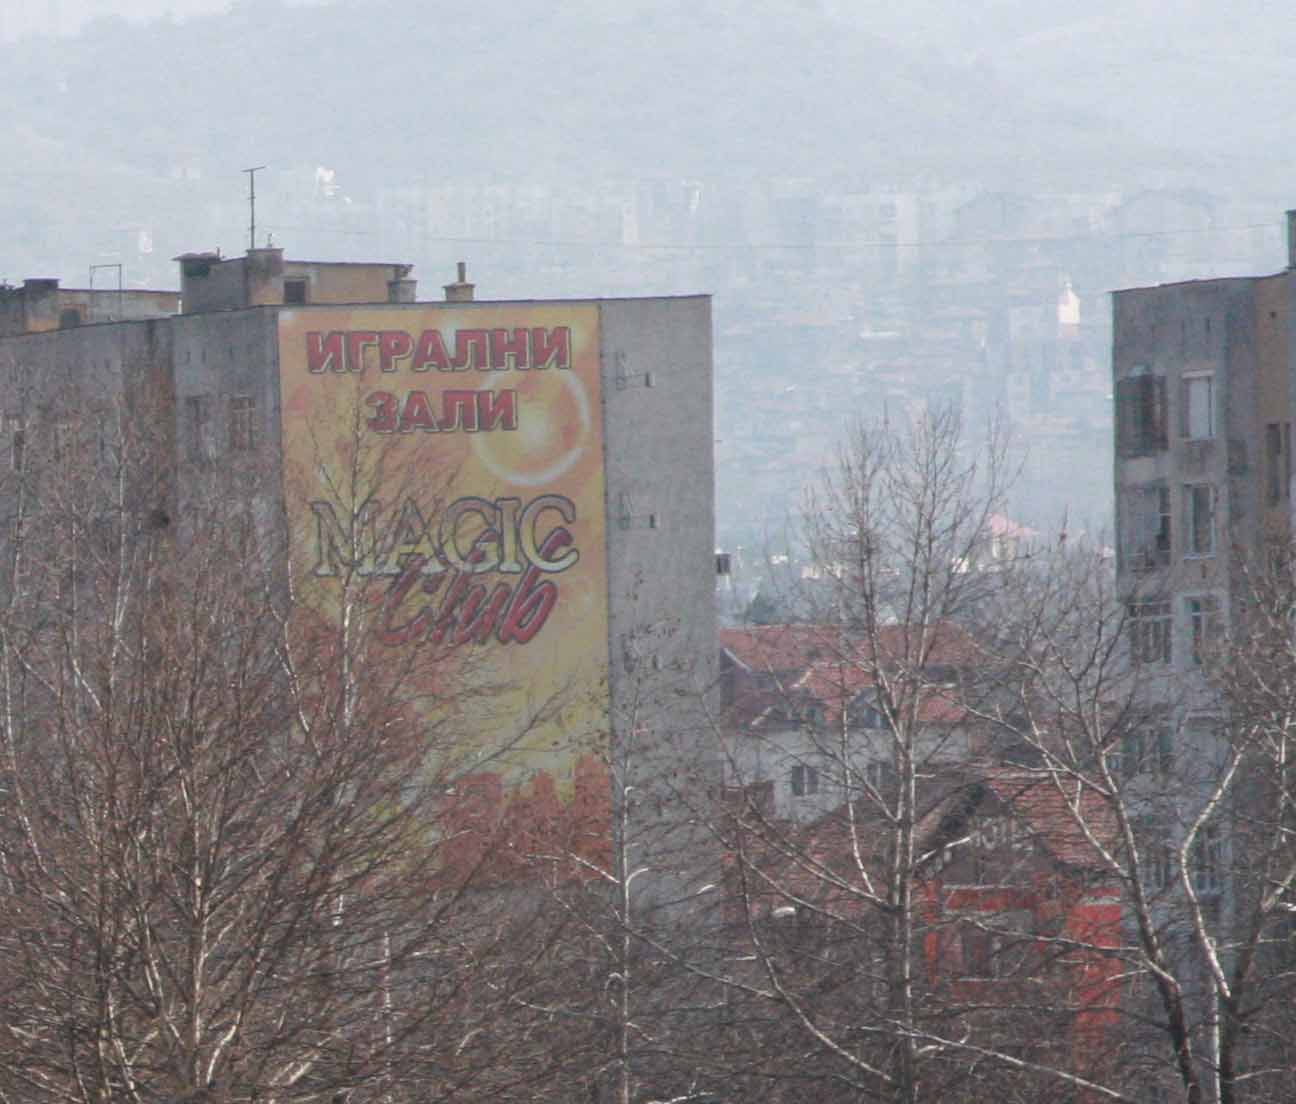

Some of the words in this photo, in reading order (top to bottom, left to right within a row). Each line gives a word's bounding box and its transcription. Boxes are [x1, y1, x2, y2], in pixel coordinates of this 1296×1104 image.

[307, 327, 572, 374] ИГРАЛНИ
[365, 389, 519, 434] ЗАЛИ
[311, 494, 579, 576] MAGIC
